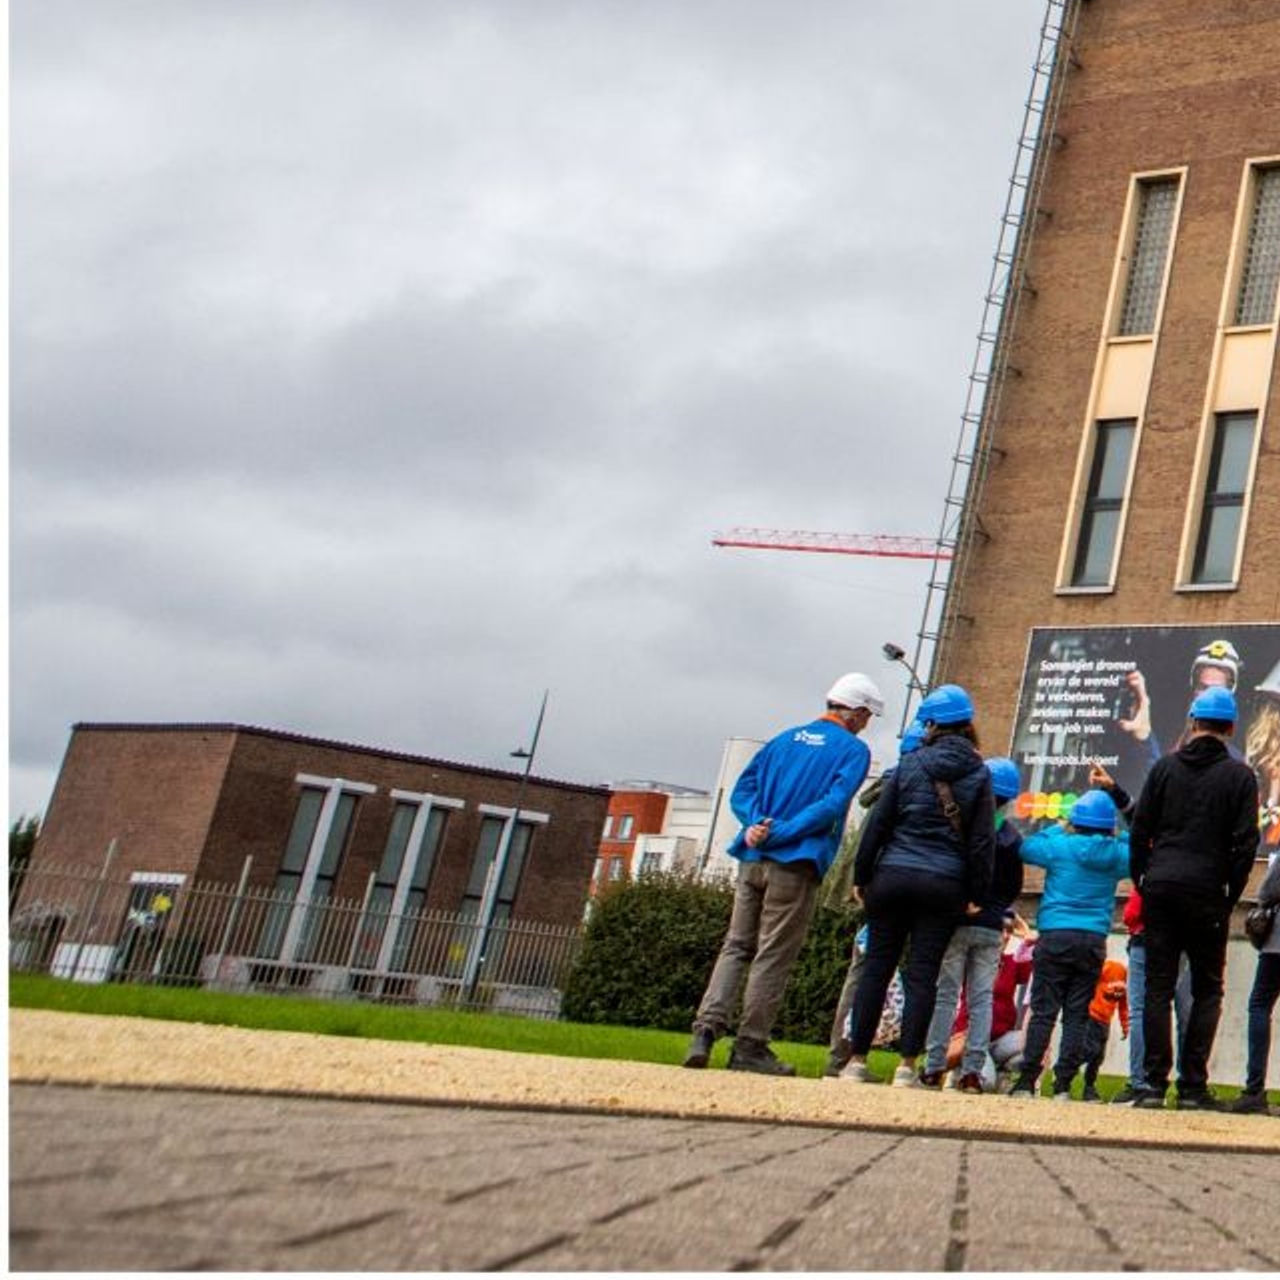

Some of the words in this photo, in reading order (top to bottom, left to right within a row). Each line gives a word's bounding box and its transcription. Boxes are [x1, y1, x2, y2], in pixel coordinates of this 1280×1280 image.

[1040, 660, 1093, 673] Sommigen
[1096, 659, 1136, 671] dromen
[1068, 675, 1081, 687] de
[1084, 674, 1119, 687] wereld
[1032, 706, 1074, 717] anderen
[1076, 706, 1111, 717] maken
[1063, 722, 1081, 735] job
[1084, 724, 1105, 733] van.
